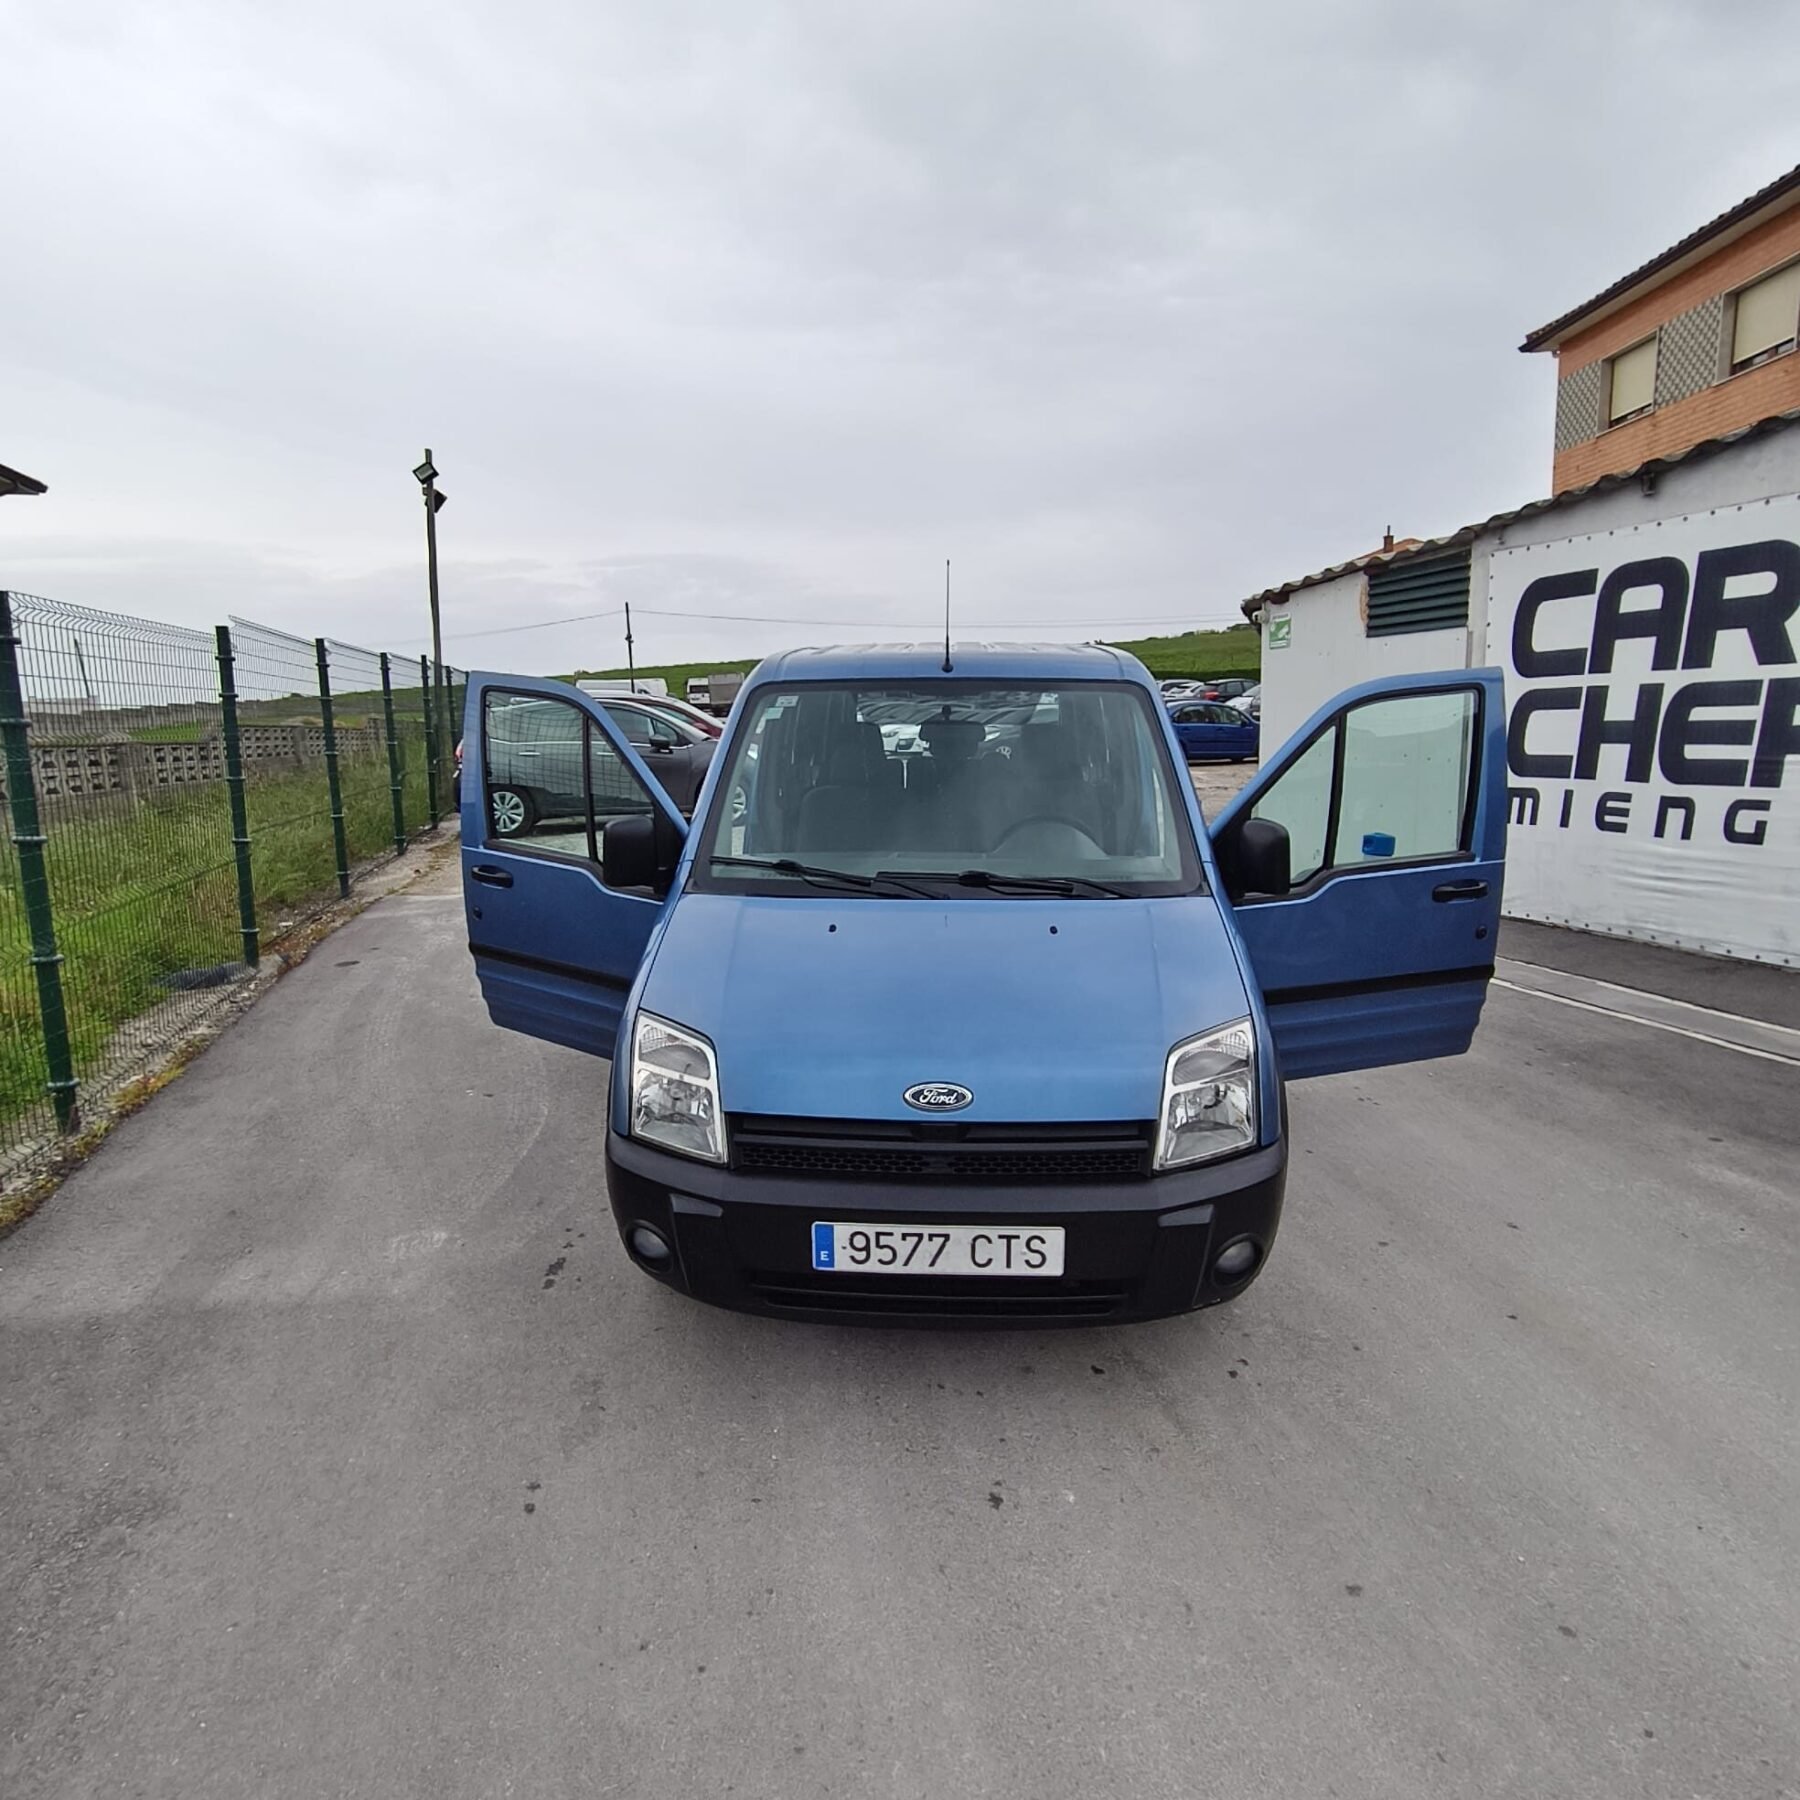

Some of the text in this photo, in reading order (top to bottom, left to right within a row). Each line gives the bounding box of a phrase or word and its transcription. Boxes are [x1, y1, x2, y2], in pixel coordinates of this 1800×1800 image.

[1511, 539, 1800, 679] CAR
[919, 1088, 958, 1104] Ford
[820, 1231, 1047, 1269] E 9577 CTS
